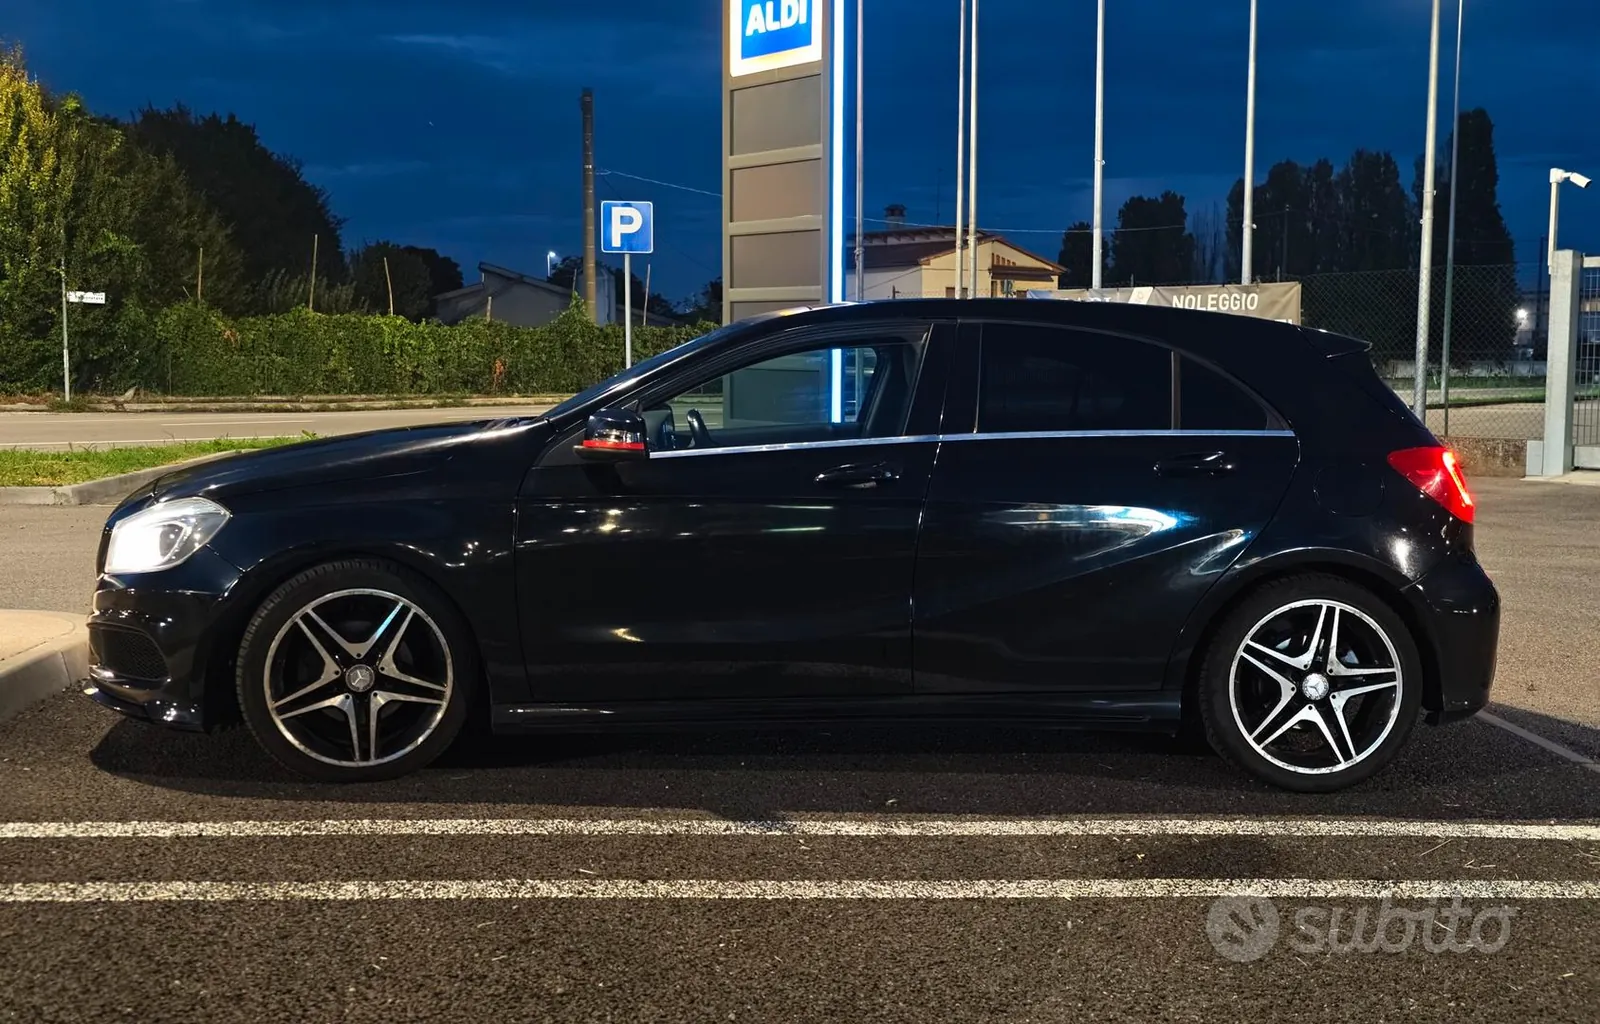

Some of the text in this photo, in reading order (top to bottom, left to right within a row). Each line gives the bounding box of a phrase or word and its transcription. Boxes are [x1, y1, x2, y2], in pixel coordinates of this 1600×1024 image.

[745, 0, 808, 36] ALDI
[611, 206, 643, 248] P
[1172, 293, 1259, 311] NOLEGGIO
